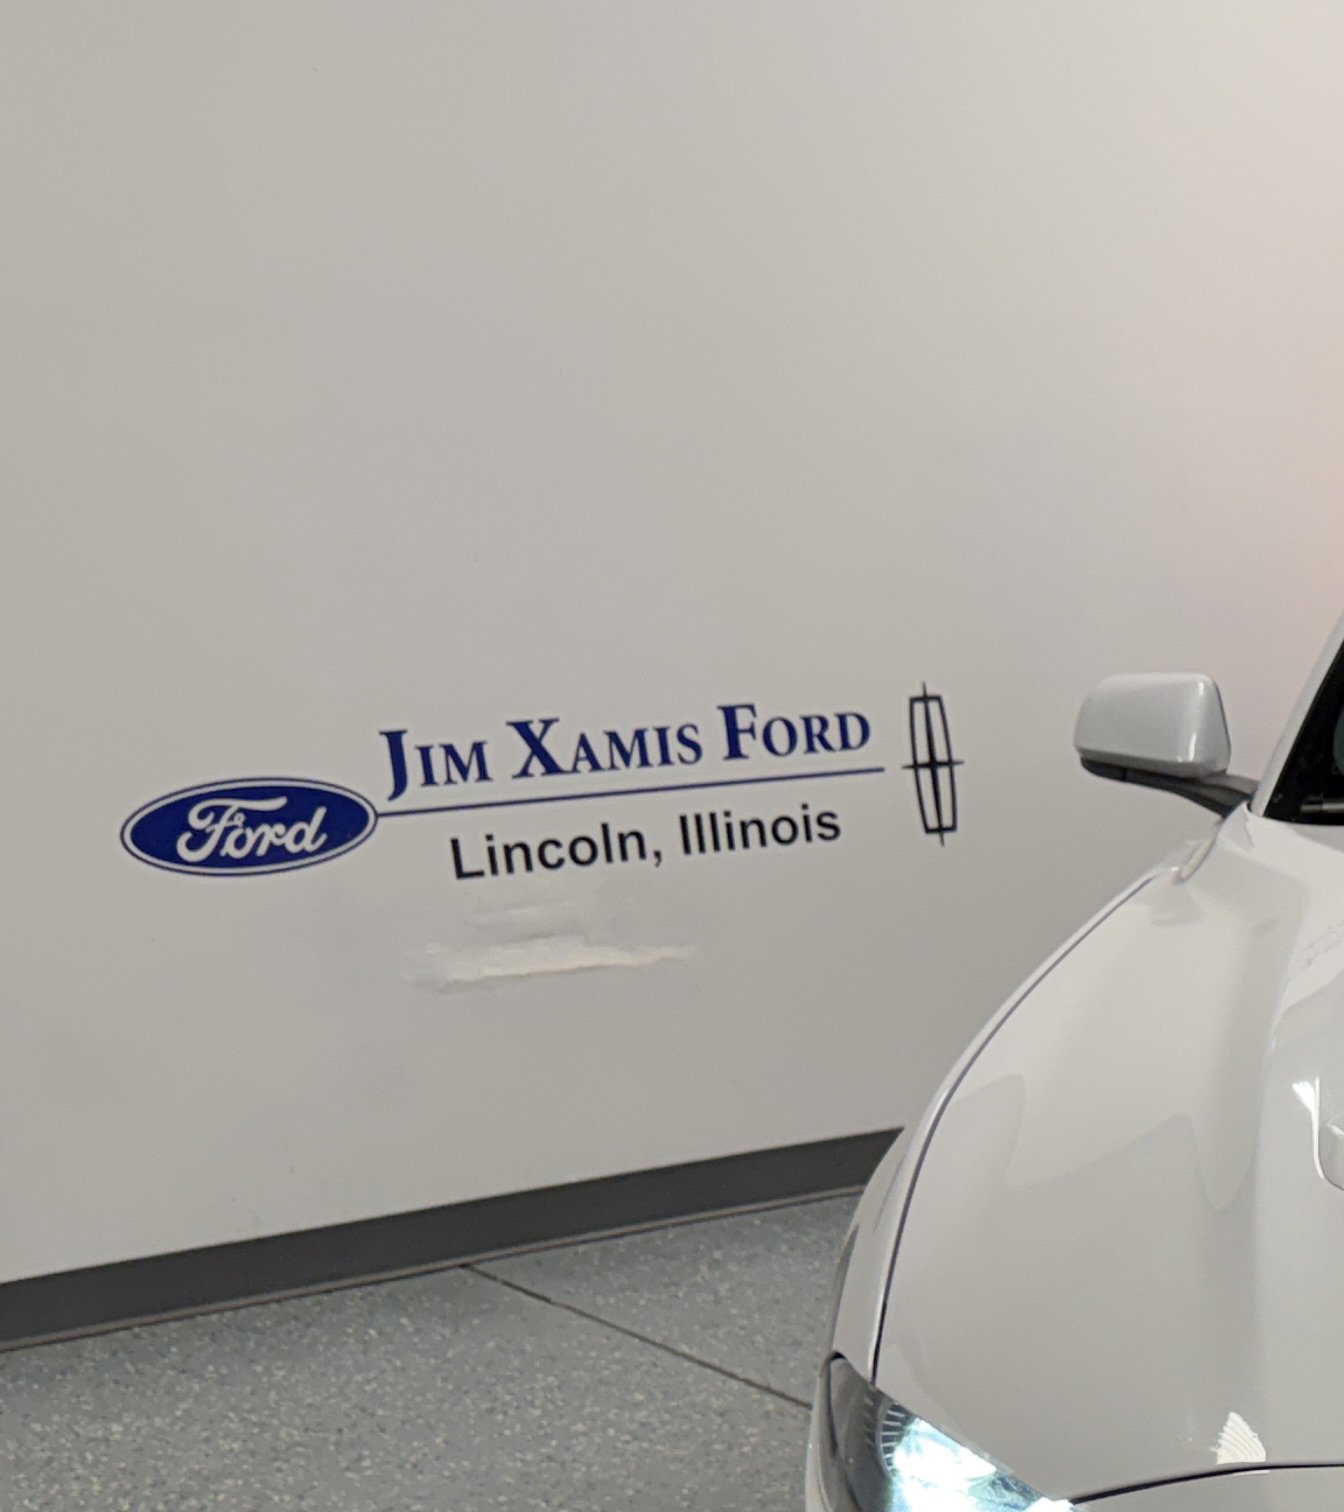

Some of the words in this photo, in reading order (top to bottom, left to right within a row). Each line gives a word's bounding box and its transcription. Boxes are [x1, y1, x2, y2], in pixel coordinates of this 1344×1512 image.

[176, 797, 328, 862] Ford
[450, 822, 662, 881] Lincoln,
[679, 803, 841, 856] Illinois
